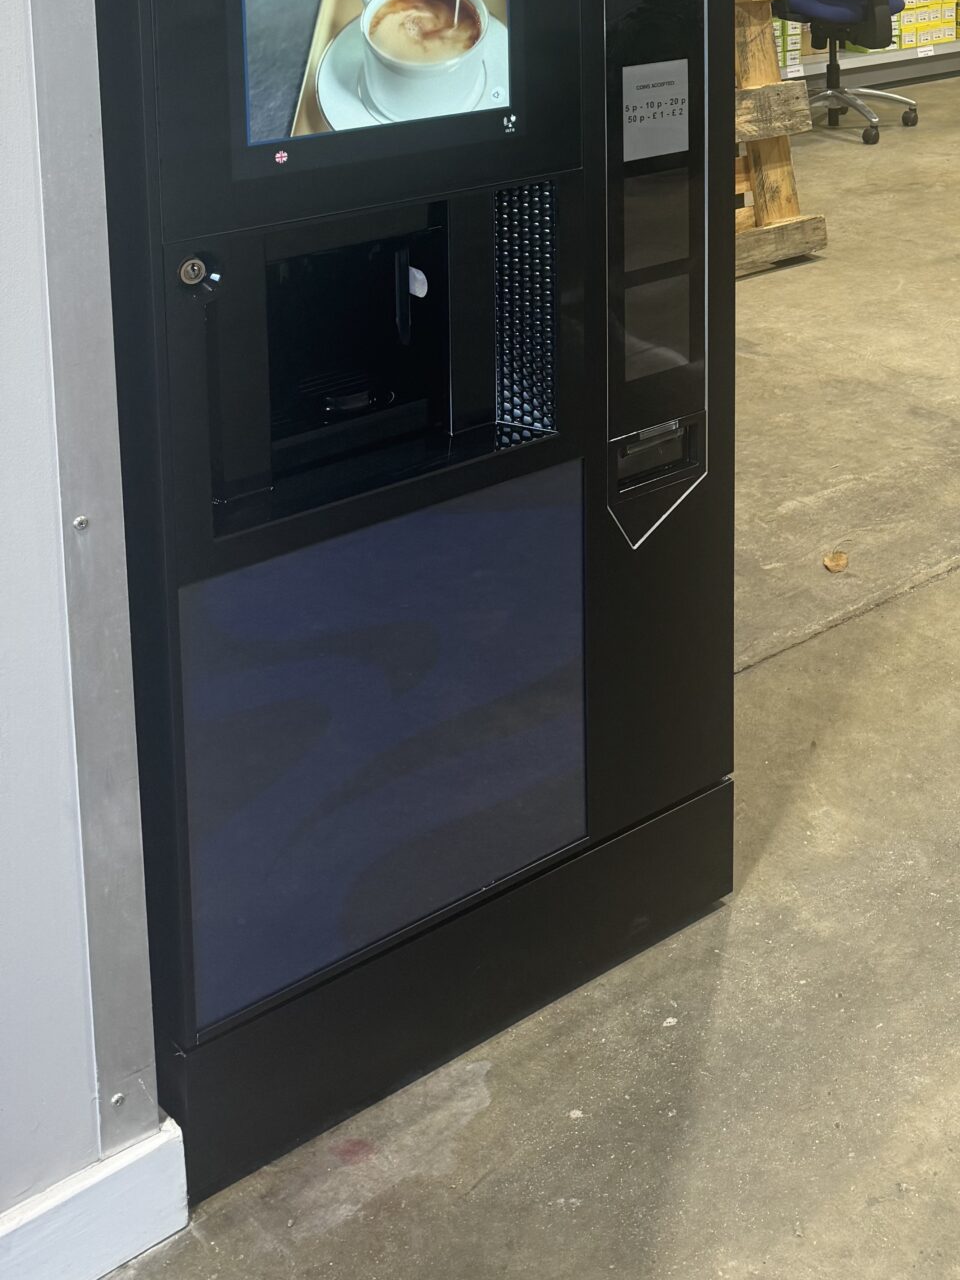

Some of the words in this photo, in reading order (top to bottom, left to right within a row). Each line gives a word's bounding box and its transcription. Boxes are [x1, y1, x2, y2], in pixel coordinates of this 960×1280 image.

[625, 105, 630, 113] 5
[632, 104, 638, 112] p
[646, 101, 655, 109] 10
[657, 100, 663, 109] p
[669, 98, 679, 106] 20
[681, 98, 686, 106] p
[628, 115, 637, 124] 50
[639, 115, 645, 123] p
[652, 111, 657, 120] £
[672, 109, 677, 117] £
[679, 108, 683, 116] 2
